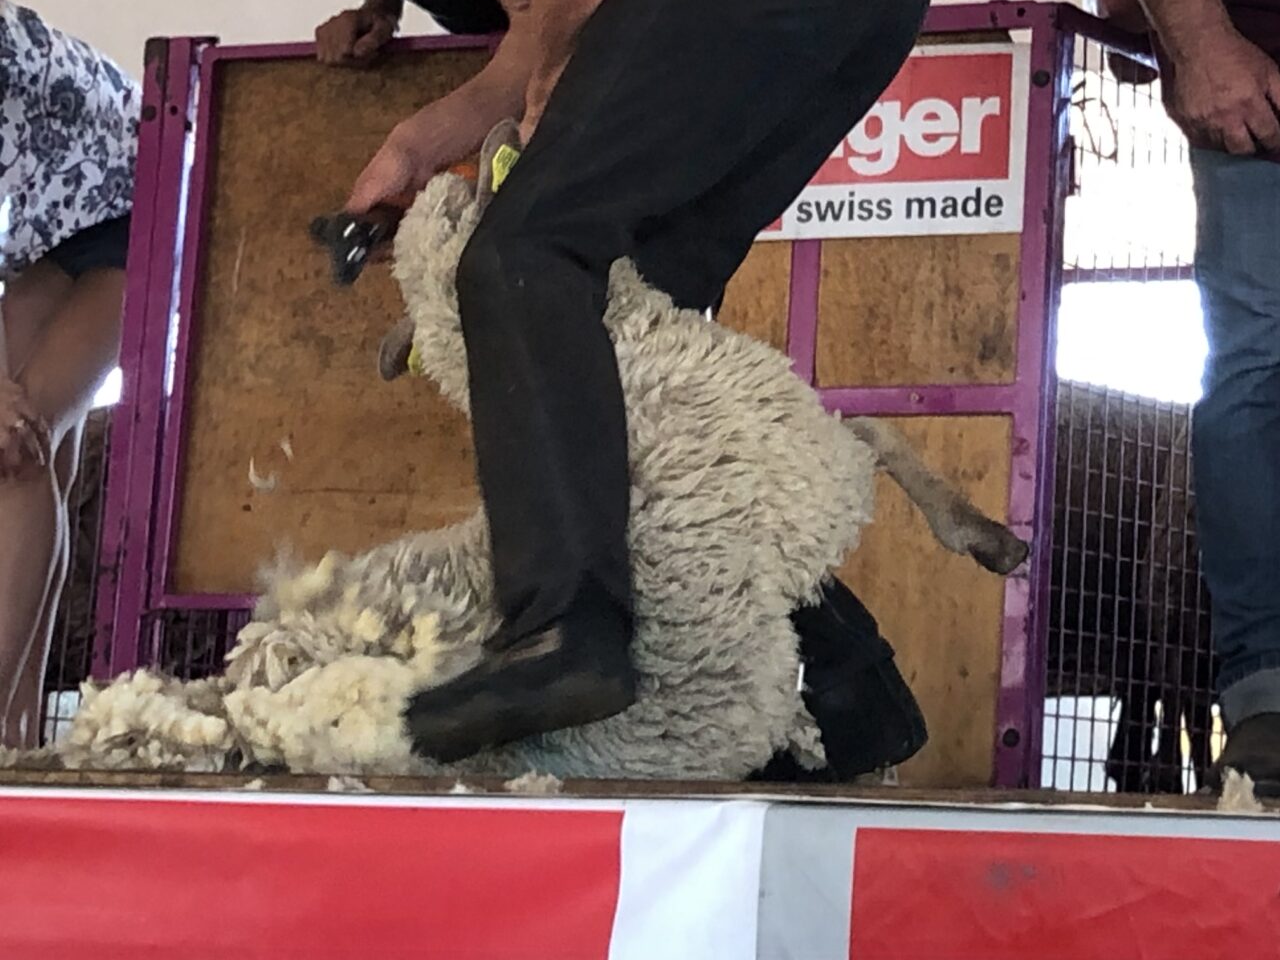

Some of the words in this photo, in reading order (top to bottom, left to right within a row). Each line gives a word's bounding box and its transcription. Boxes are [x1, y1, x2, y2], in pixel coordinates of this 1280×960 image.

[831, 96, 1000, 177] ger
[796, 192, 893, 223] swiss
[905, 187, 1005, 219] made
